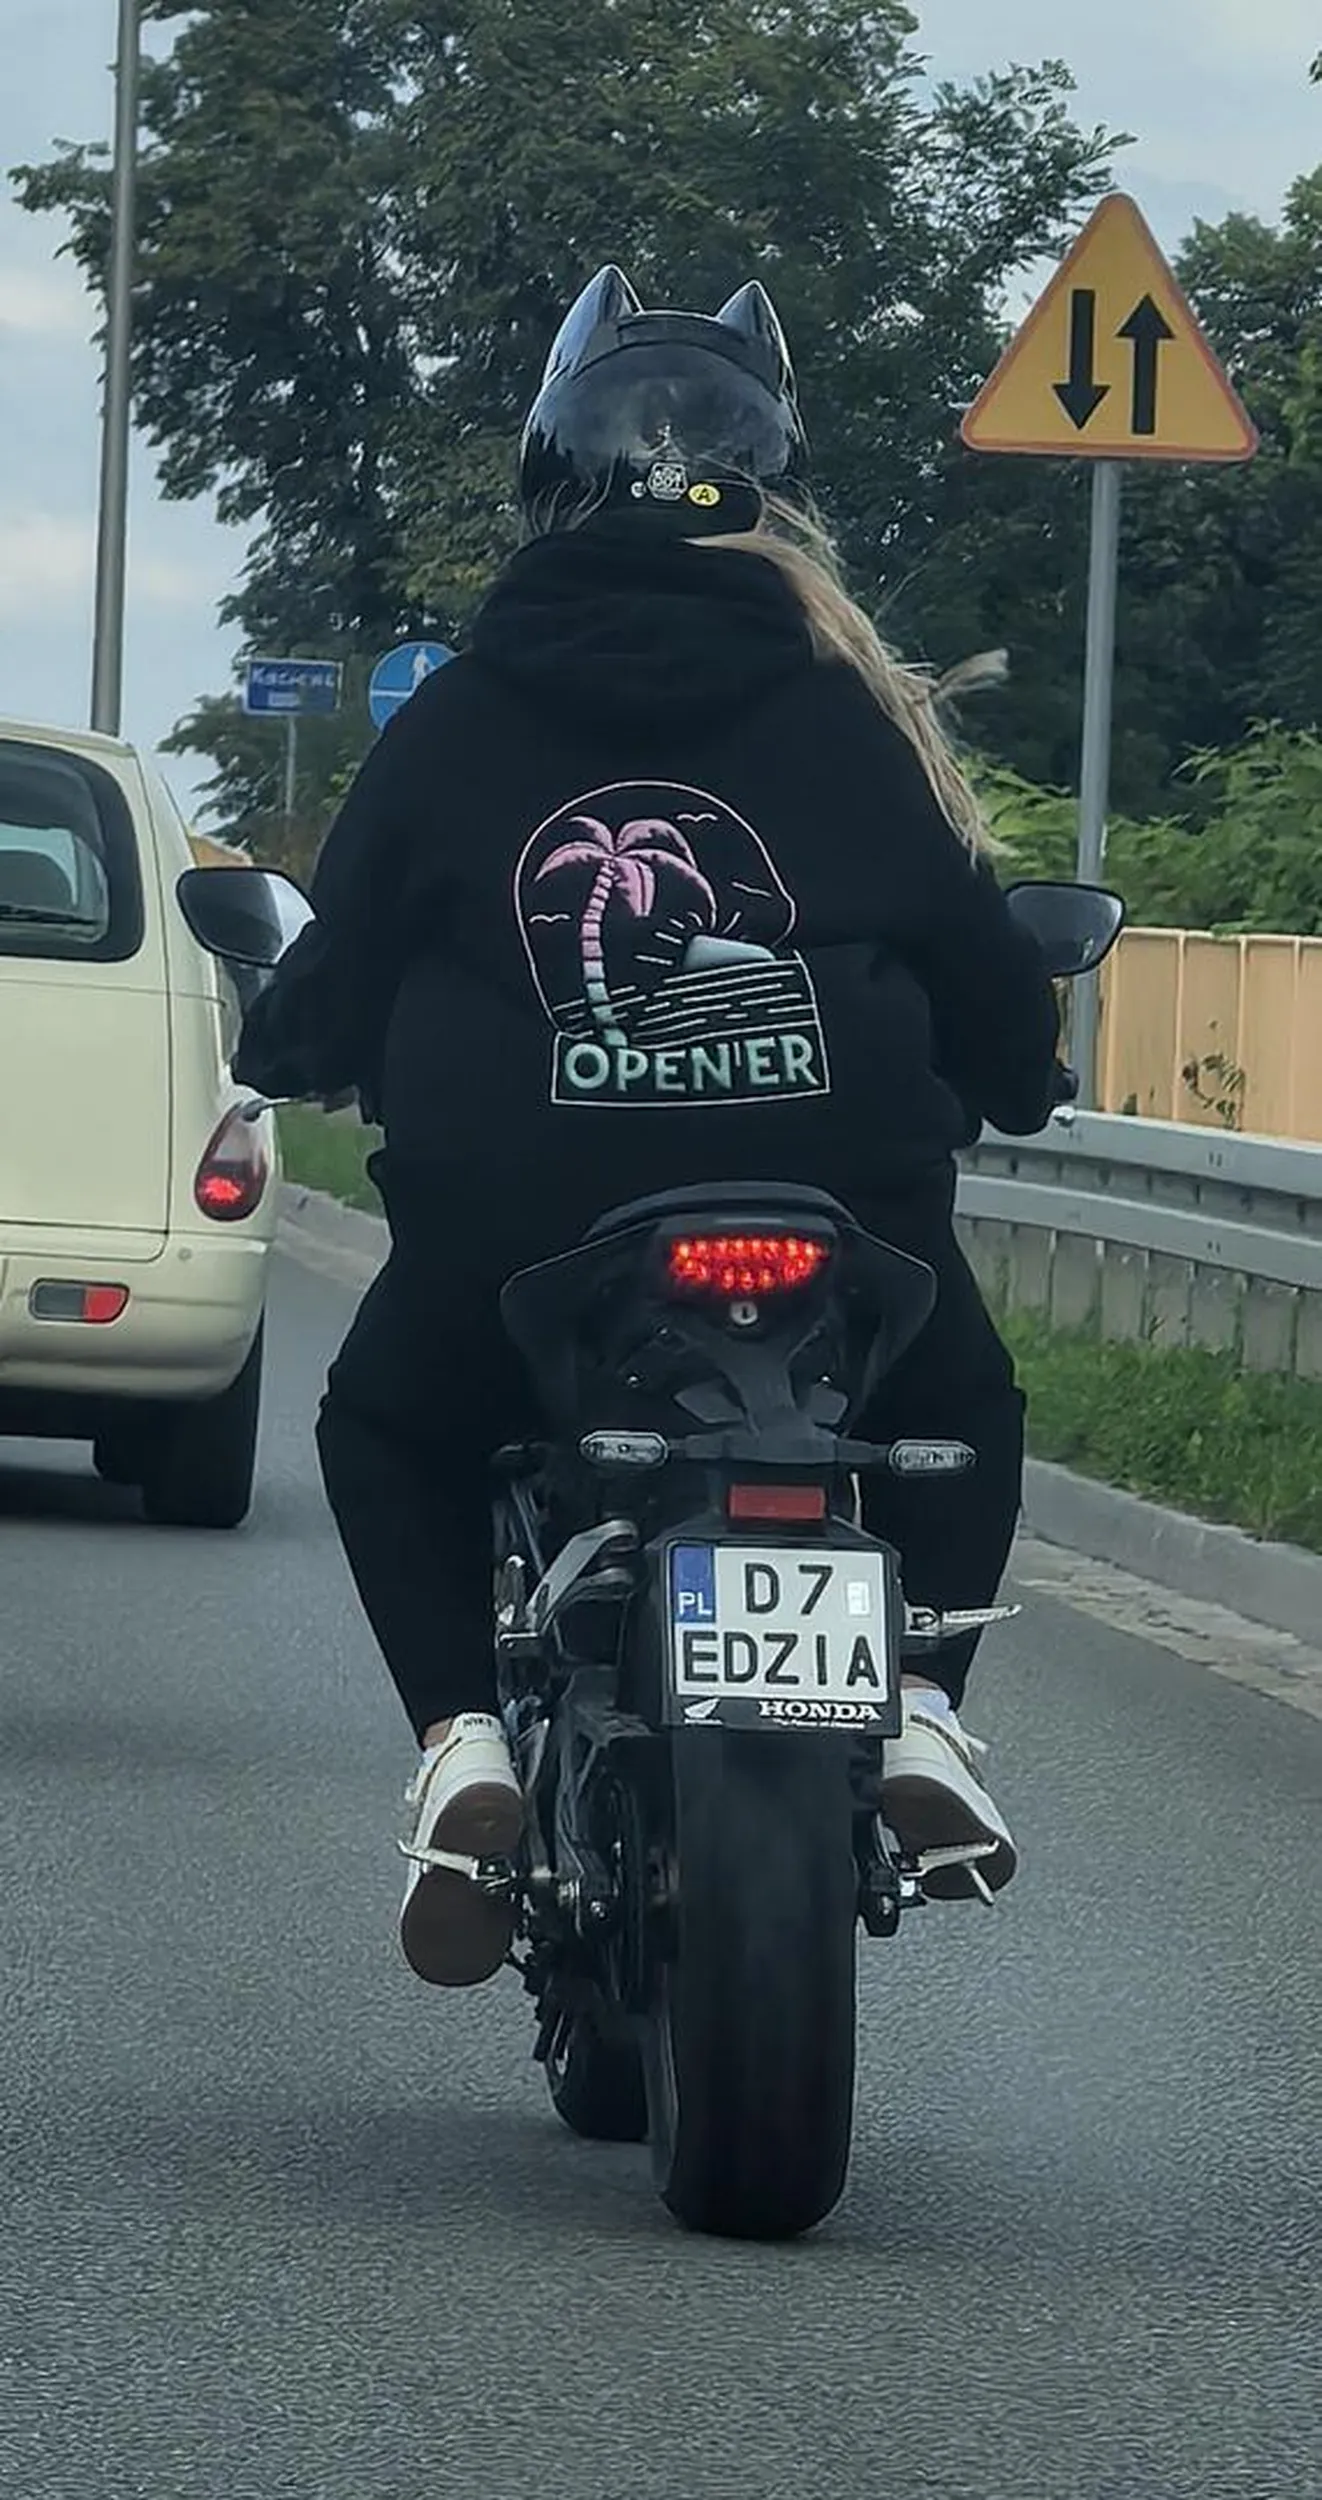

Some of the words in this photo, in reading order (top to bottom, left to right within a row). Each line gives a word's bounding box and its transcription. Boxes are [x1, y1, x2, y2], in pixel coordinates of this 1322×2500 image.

[696, 486, 712, 503] A
[564, 1033, 820, 1091] OPEN'ER
[678, 1591, 713, 1616] PL
[682, 1630, 880, 1688] EDZIA
[758, 1700, 883, 1721] HONDA
